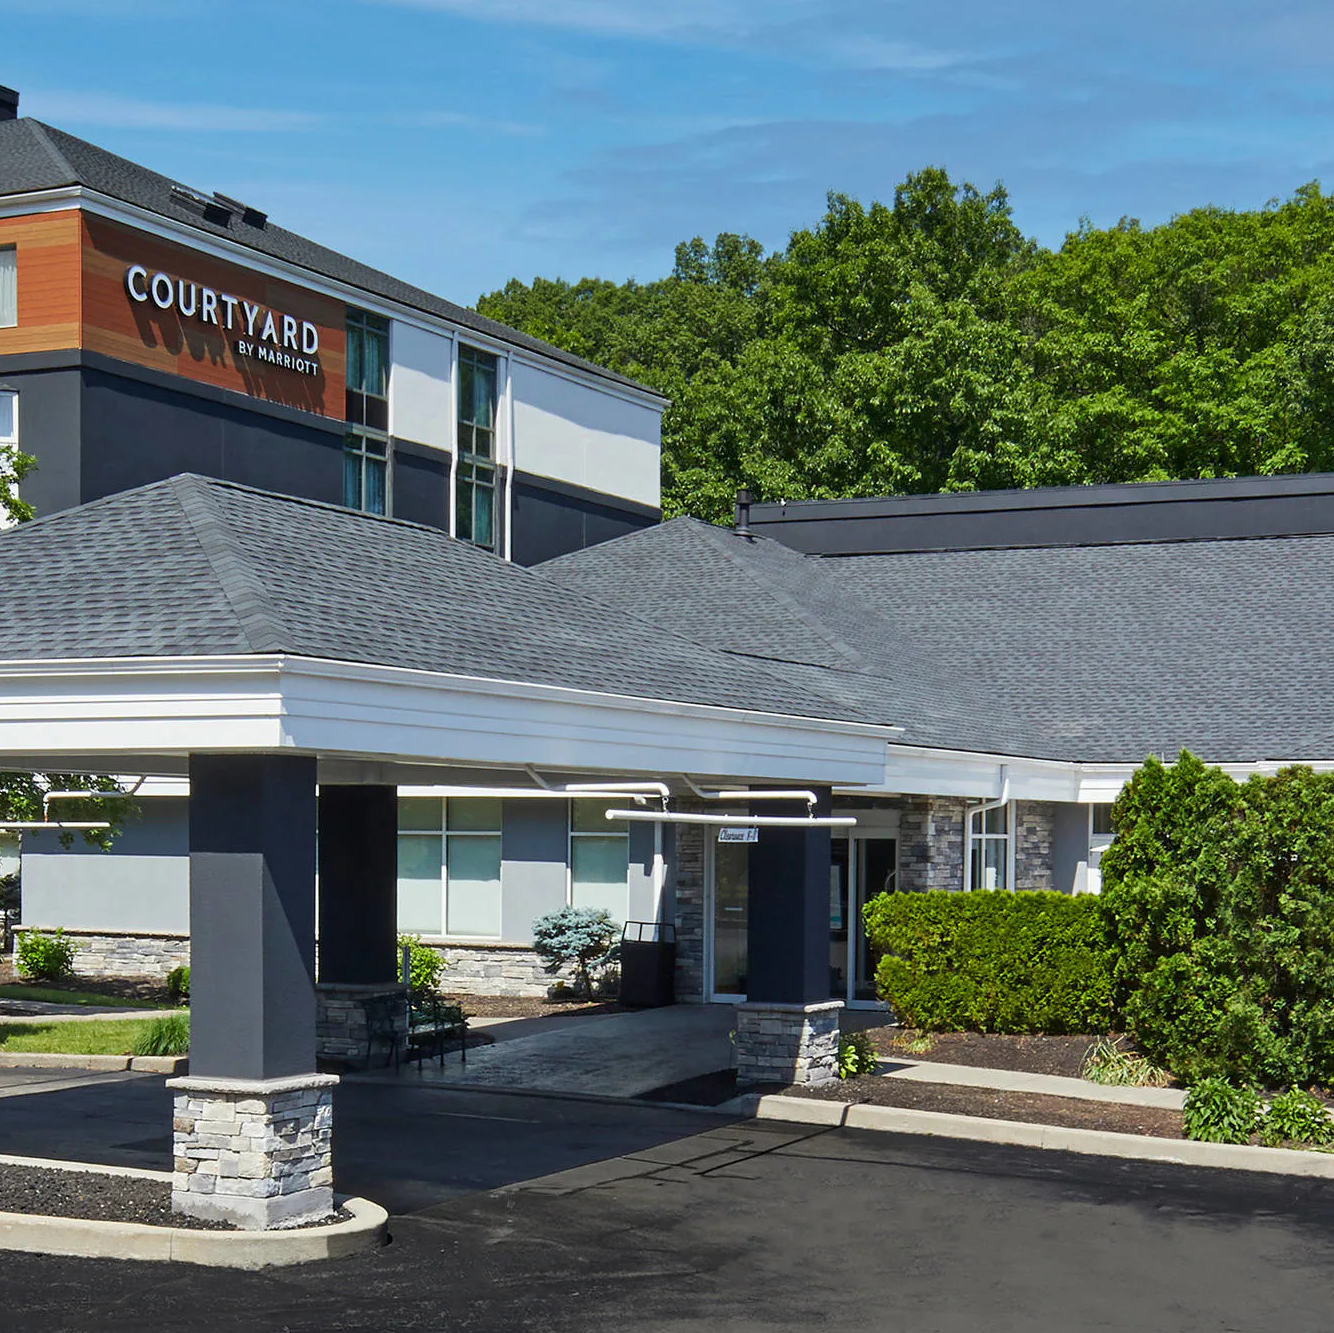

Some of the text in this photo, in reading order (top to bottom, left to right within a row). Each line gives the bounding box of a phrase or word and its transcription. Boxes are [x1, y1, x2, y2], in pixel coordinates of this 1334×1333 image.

[126, 264, 319, 355] COURTYARD
[238, 340, 318, 376] BY MARRIOTT
